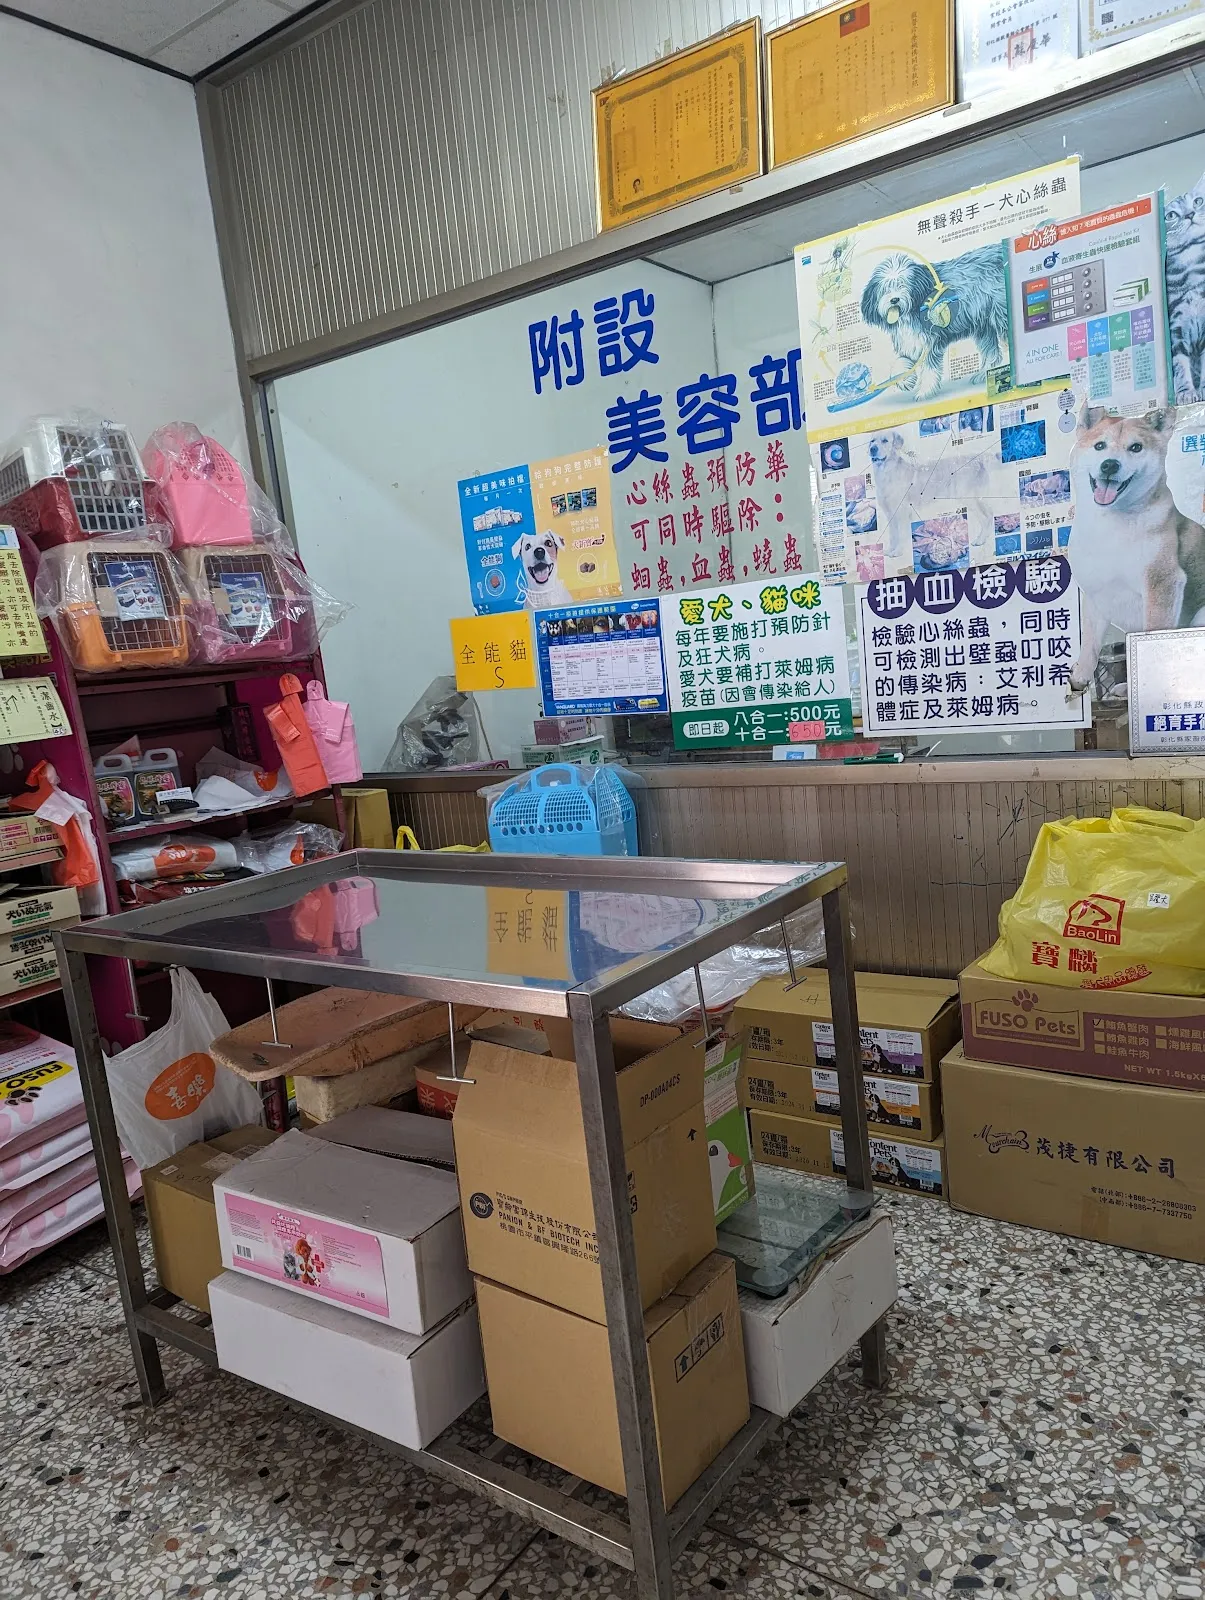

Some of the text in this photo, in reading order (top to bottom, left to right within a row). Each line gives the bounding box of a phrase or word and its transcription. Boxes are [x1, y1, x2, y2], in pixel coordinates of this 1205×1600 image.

[528, 288, 660, 395] 附設
[1032, 348, 1040, 357] IN
[1041, 343, 1059, 354] ONE
[605, 347, 806, 474] 美容部
[627, 439, 790, 506] 心絲蟲預防藥
[875, 558, 1063, 612] 抽血檢驗
[679, 579, 822, 626] 愛犬、貓咪
[675, 610, 831, 648] 每年要施打預防針
[459, 639, 528, 666] 全能貓
[494, 666, 505, 689] S
[679, 655, 836, 688] 愛犬要補打萊姆病
[688, 721, 724, 736] 即日起
[1067, 925, 1117, 944] BaoLin
[980, 1010, 1076, 1036] FUSO Pets
[5, 1063, 64, 1089] FUSO
[1124, 1063, 1144, 1073] NET
[1146, 1067, 1162, 1076] WT
[873, 1147, 893, 1158] Pets
[1036, 1137, 1176, 1179] 茂捷有限公司
[498, 1211, 523, 1227] PANION
[537, 1225, 545, 1235] BF
[550, 1229, 581, 1247] BIOTECH
